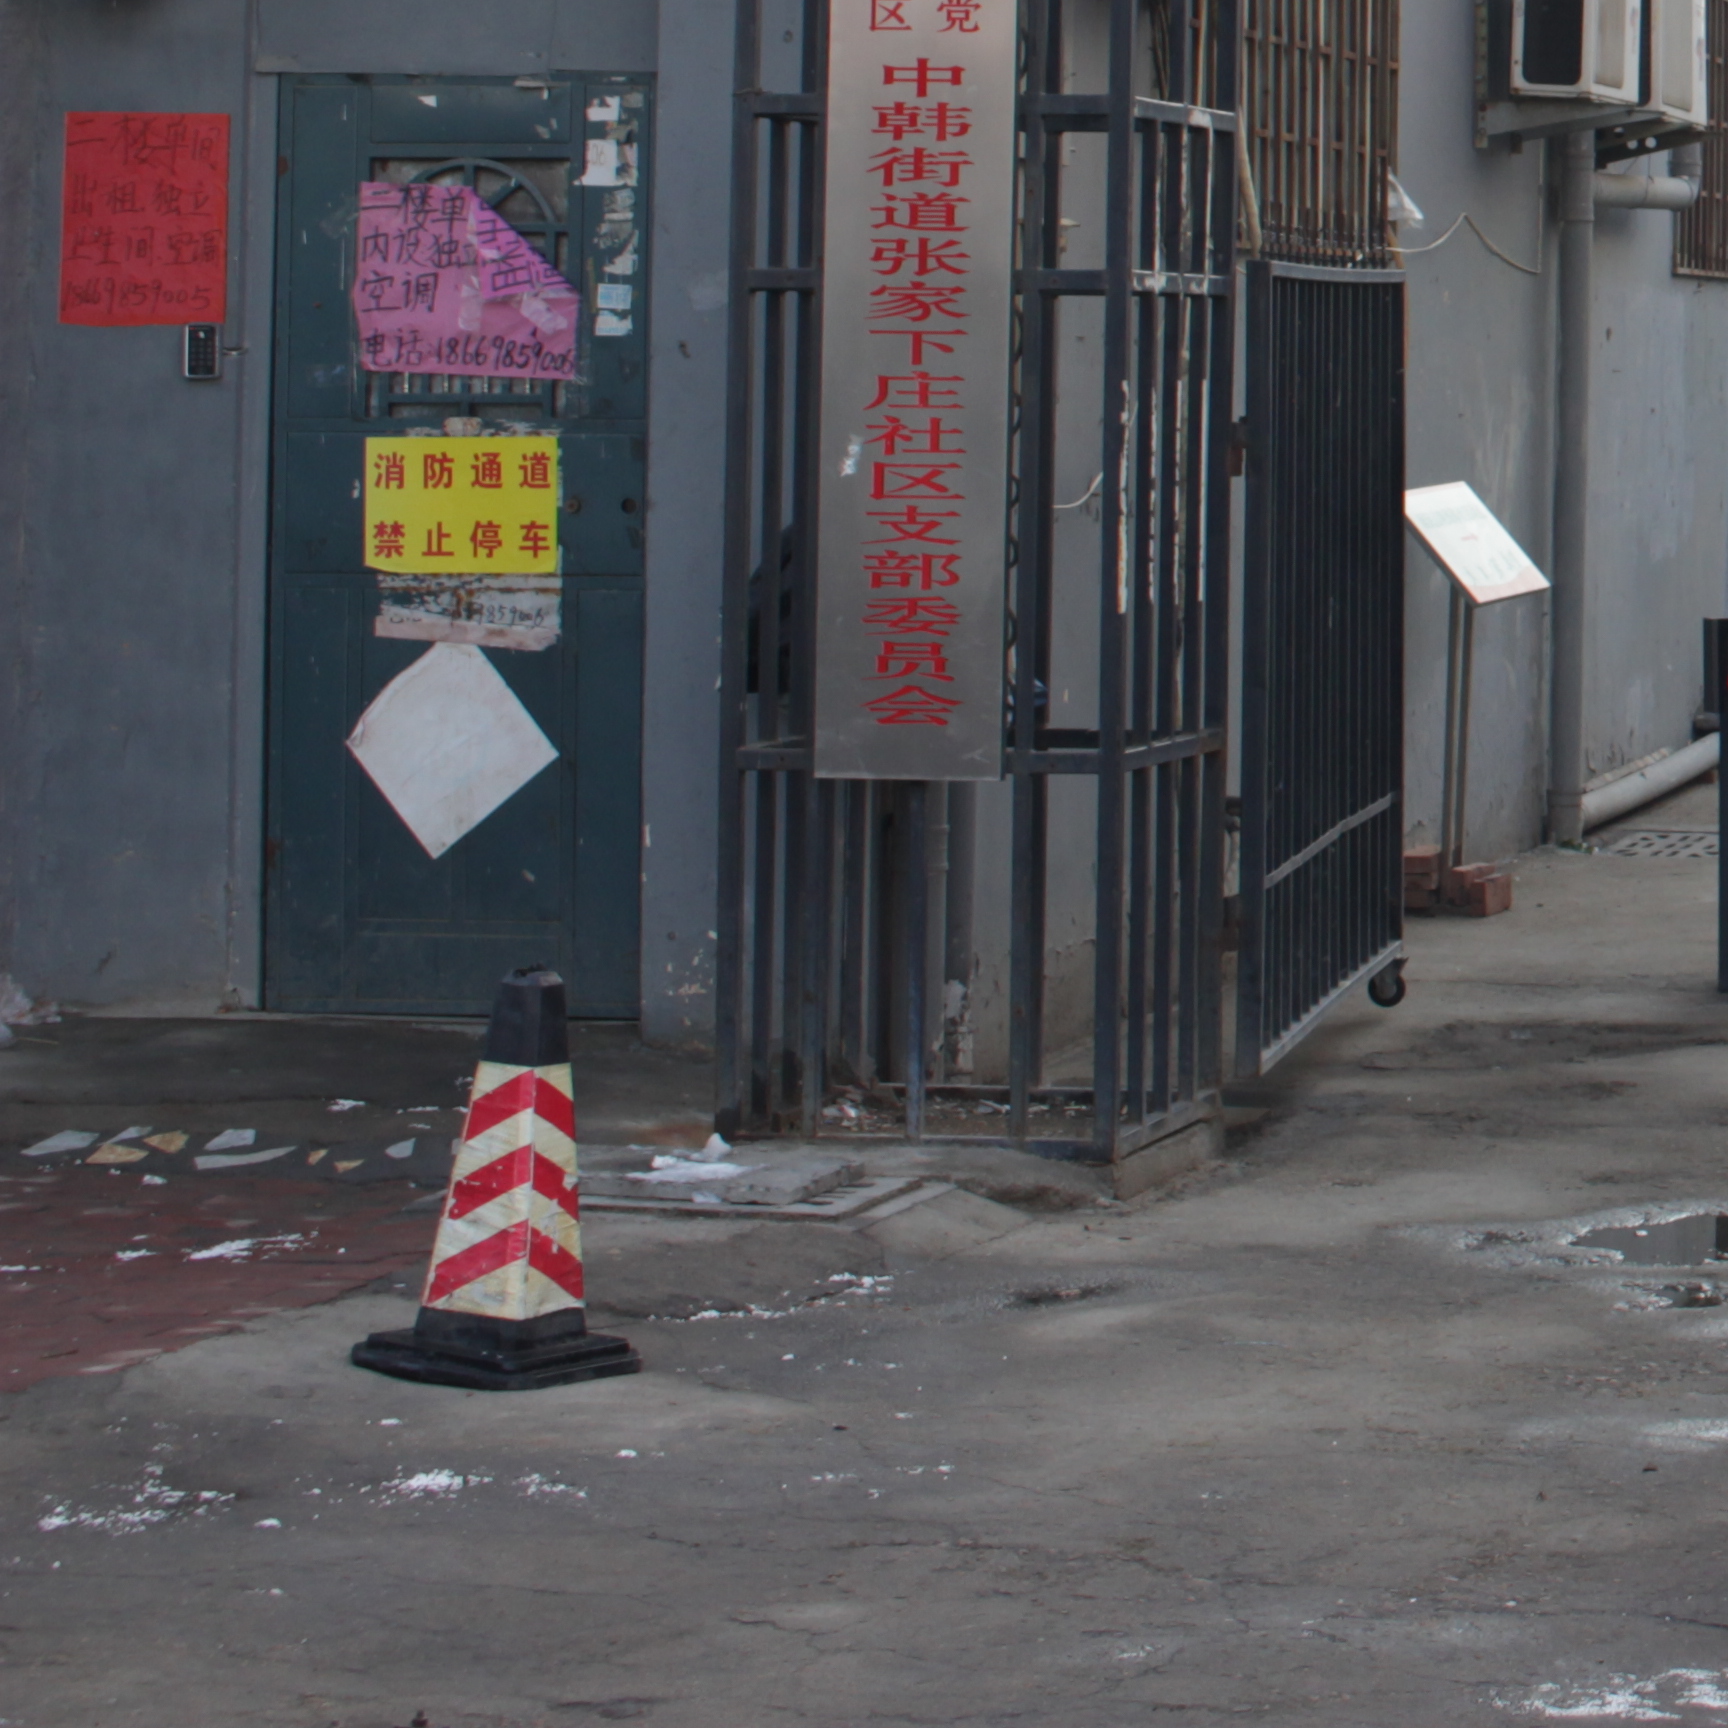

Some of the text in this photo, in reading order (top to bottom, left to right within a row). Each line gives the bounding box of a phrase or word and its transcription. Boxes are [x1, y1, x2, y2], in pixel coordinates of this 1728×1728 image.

[361, 269, 439, 313] 空调
[862, 57, 974, 727] 中韩街道张家下庄社区支部委员会
[373, 451, 552, 489] 消防通道
[373, 520, 551, 559] 禁止停车
